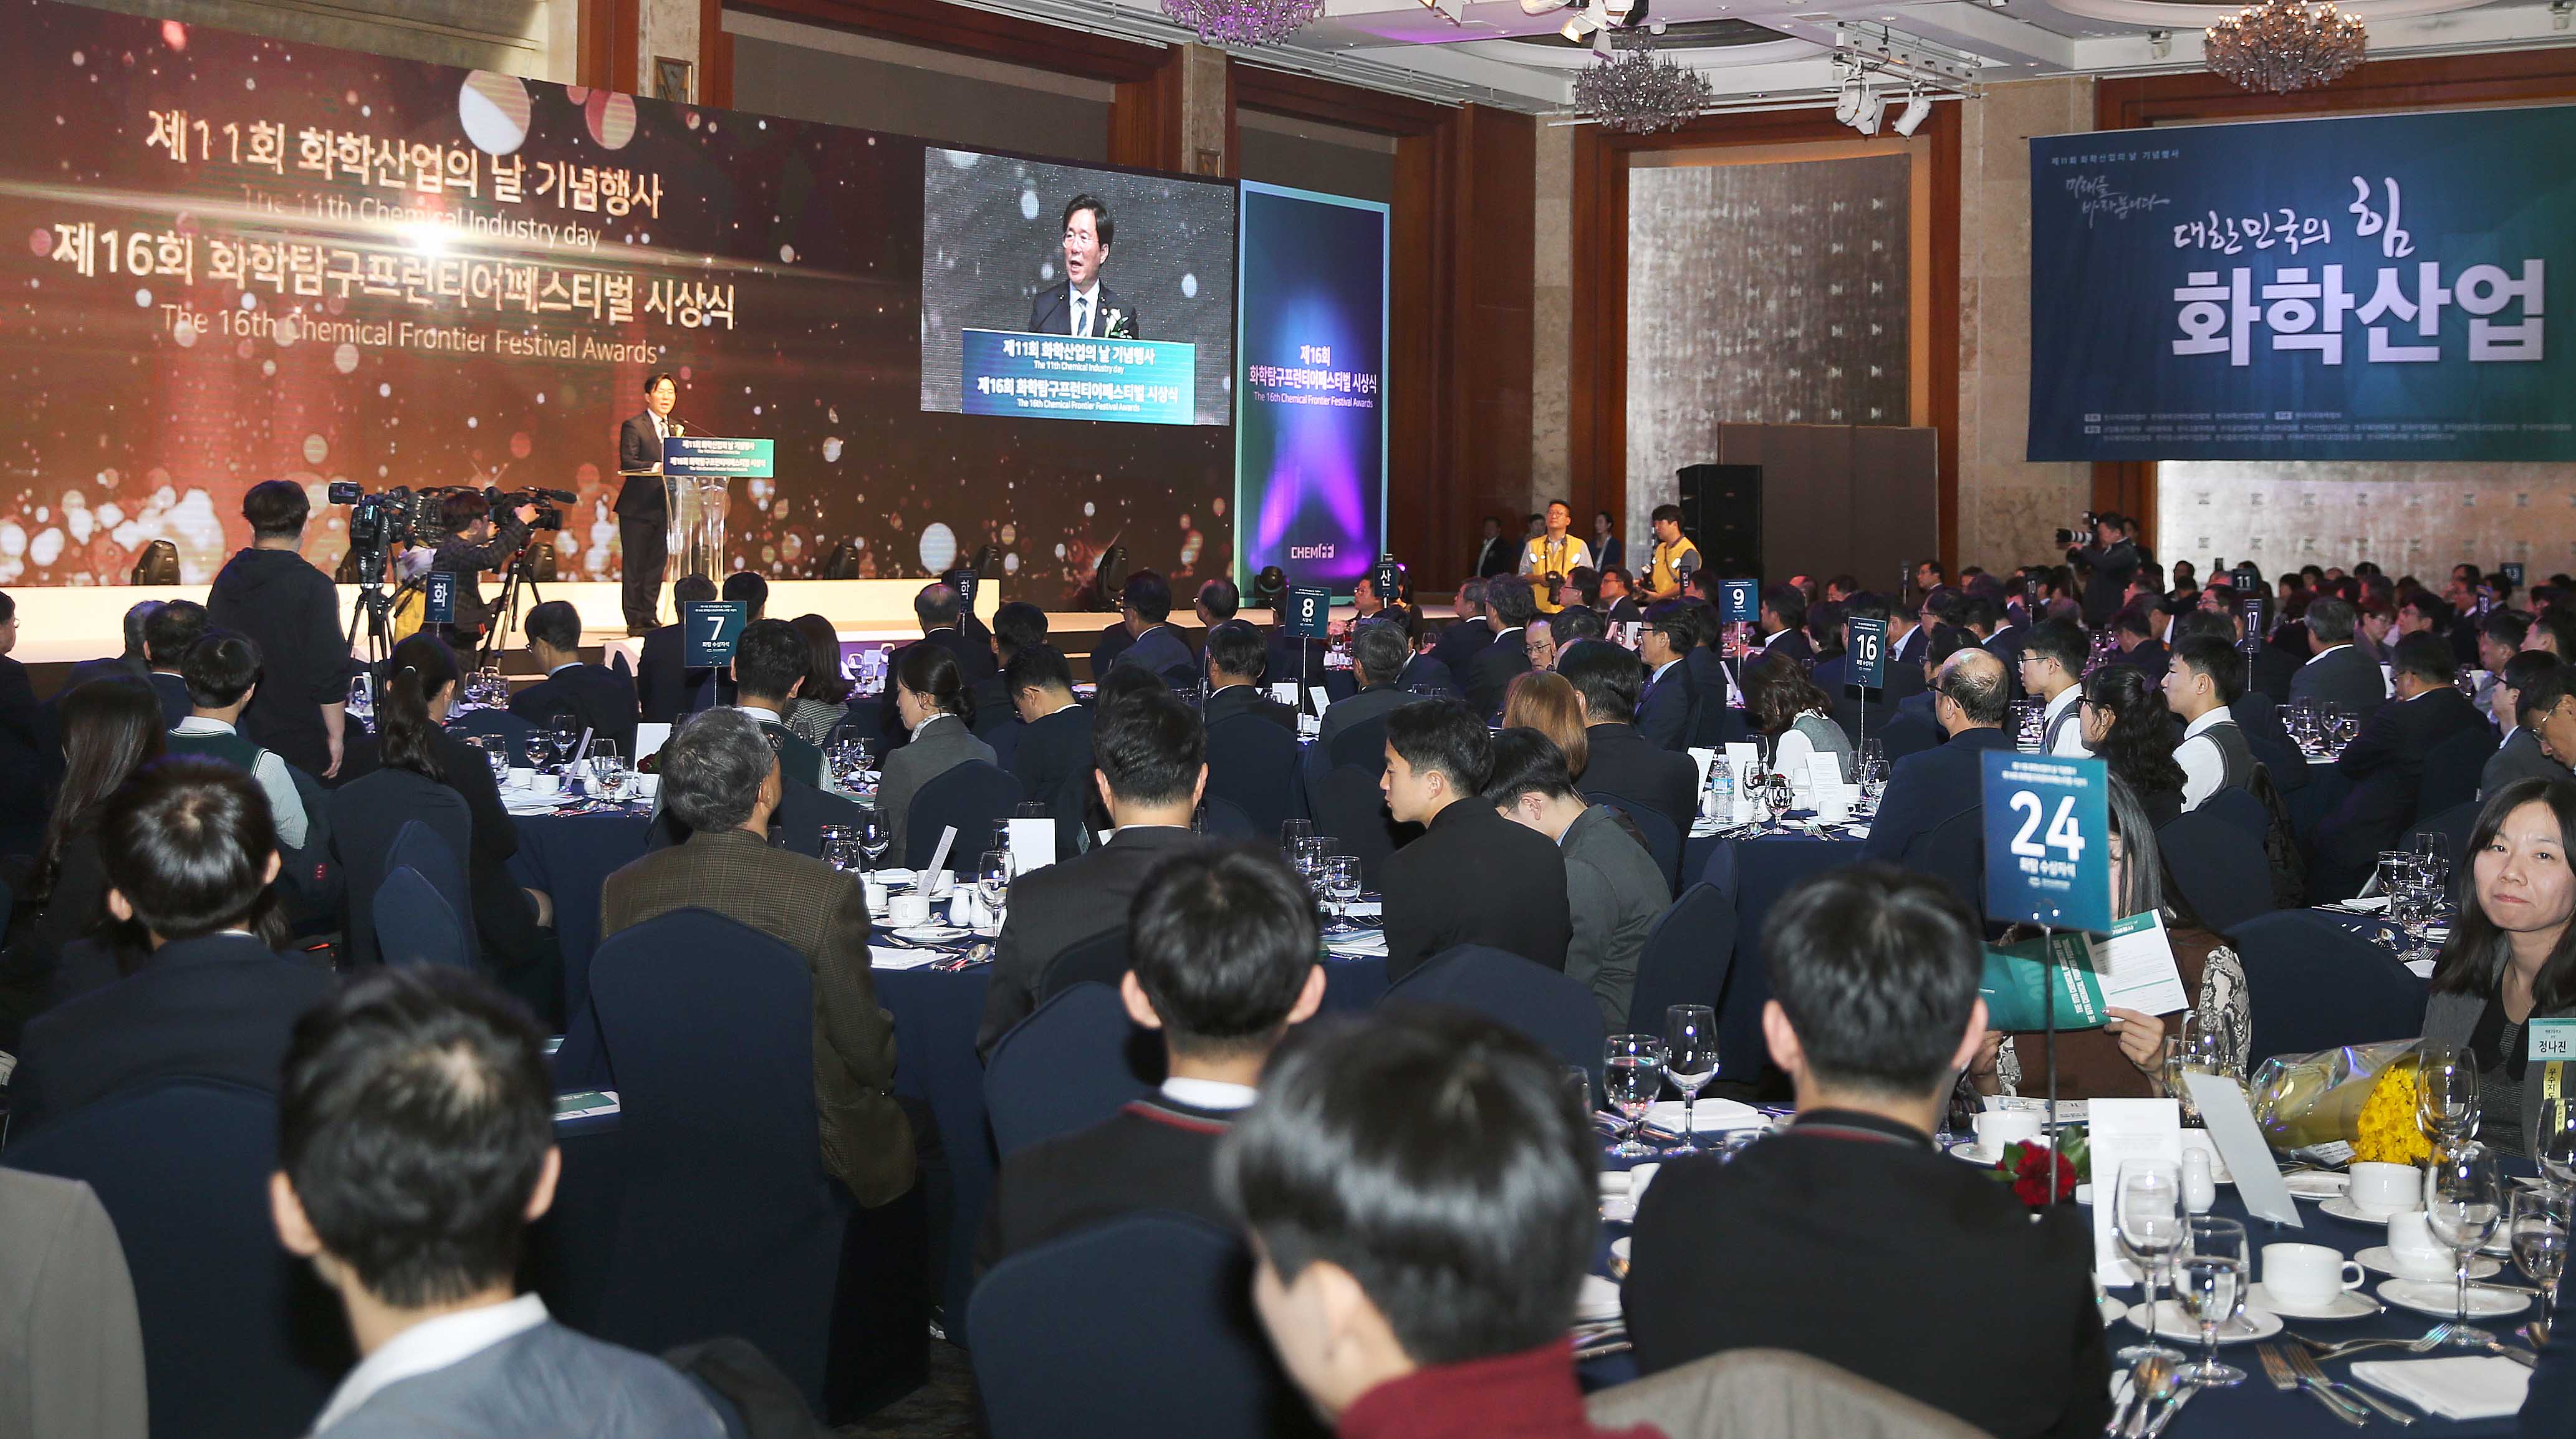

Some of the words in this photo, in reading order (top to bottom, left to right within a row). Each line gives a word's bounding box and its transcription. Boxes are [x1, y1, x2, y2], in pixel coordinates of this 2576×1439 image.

[146, 110, 285, 175] 제11회
[298, 127, 478, 198] 화학산업의
[491, 154, 526, 204] 날
[536, 160, 663, 219] 기념행사
[360, 196, 462, 233] Chemical
[469, 209, 559, 248] Industry
[564, 219, 600, 253] day
[2174, 209, 2331, 256] 대한민국의
[2349, 175, 2415, 258] 힘
[52, 222, 193, 286] 제16회
[208, 234, 633, 323] 화학탐구프런티어페스티벌
[644, 278, 734, 330] 시상식
[2172, 259, 2545, 367] 화학산업
[160, 304, 208, 334] The
[219, 309, 277, 339] 16th
[284, 312, 393, 346] Chemical
[400, 321, 488, 352] Frontier
[496, 329, 577, 359] Festival
[582, 339, 657, 365] Awards
[1002, 339, 1039, 358] 제11회
[1042, 341, 1097, 362] 화학산업의
[1098, 344, 1110, 363] 날
[1113, 346, 1155, 365] 기념행사
[1300, 345, 1331, 367] 제16회
[1034, 360, 1045, 368] The
[1061, 361, 1088, 372] Chemical
[977, 376, 1014, 395] 제16회
[1148, 385, 1179, 403] 시상식
[1250, 365, 1352, 392] 화학탐구프런티어페스티벌
[1353, 373, 1377, 393] 시상식
[1017, 398, 1028, 407] The
[1044, 400, 1070, 409] Chemical
[1254, 392, 1265, 402] The
[1267, 392, 1280, 402] 16th
[1281, 393, 1307, 404] Chemical
[1308, 395, 1330, 406] Frontier
[1331, 396, 1352, 407] Festival
[1353, 398, 1373, 408] Awards
[961, 579, 971, 600] 학
[1380, 569, 1391, 586] 산
[2237, 576, 2251, 587] 11
[433, 582, 448, 607] 화
[1733, 589, 1744, 605] 9
[1302, 598, 1314, 617] 8
[708, 616, 724, 641] 7
[2247, 612, 2257, 631] 17
[1857, 633, 1877, 660] 16
[2009, 790, 2085, 861] 24
[2539, 1040, 2566, 1054] 정나진
